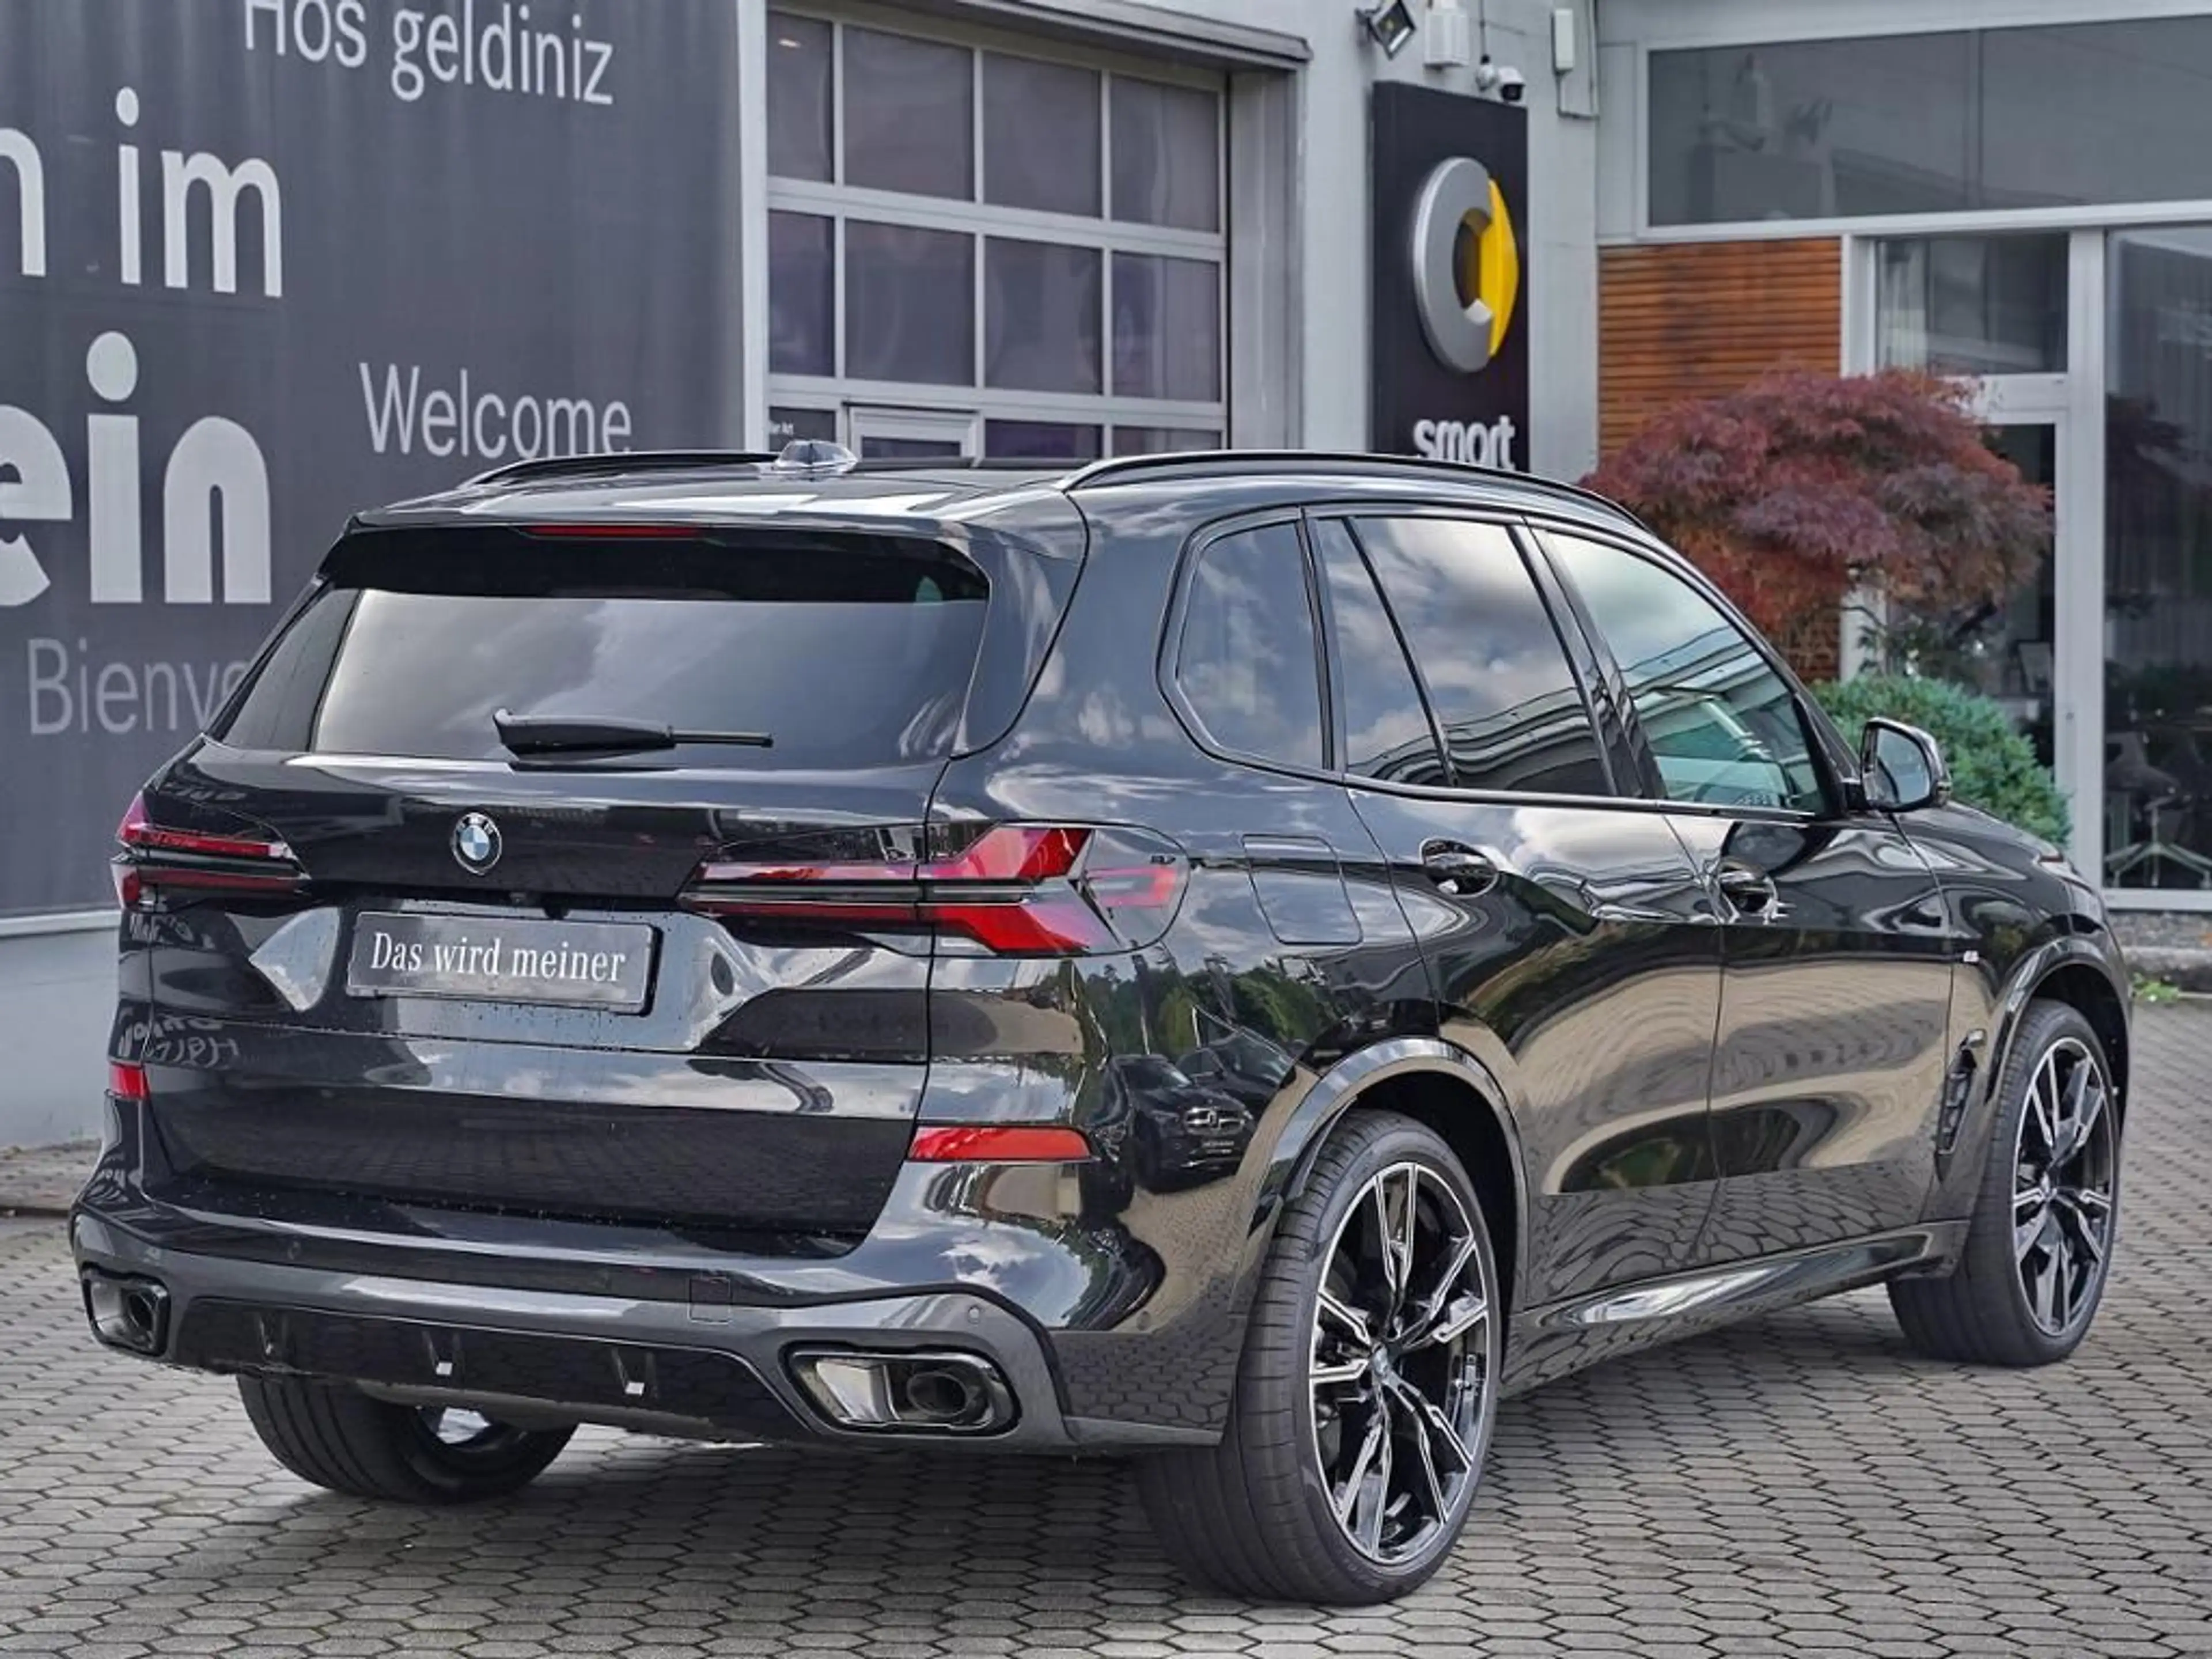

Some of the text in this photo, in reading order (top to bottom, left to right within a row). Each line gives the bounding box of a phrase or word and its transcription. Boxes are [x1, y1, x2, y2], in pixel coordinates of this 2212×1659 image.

[244, 0, 613, 105] Hos geldiniz
[115, 86, 283, 298] im
[359, 362, 632, 459] Welcome
[0, 331, 272, 607] ein
[370, 931, 626, 982] Das wird meiner
